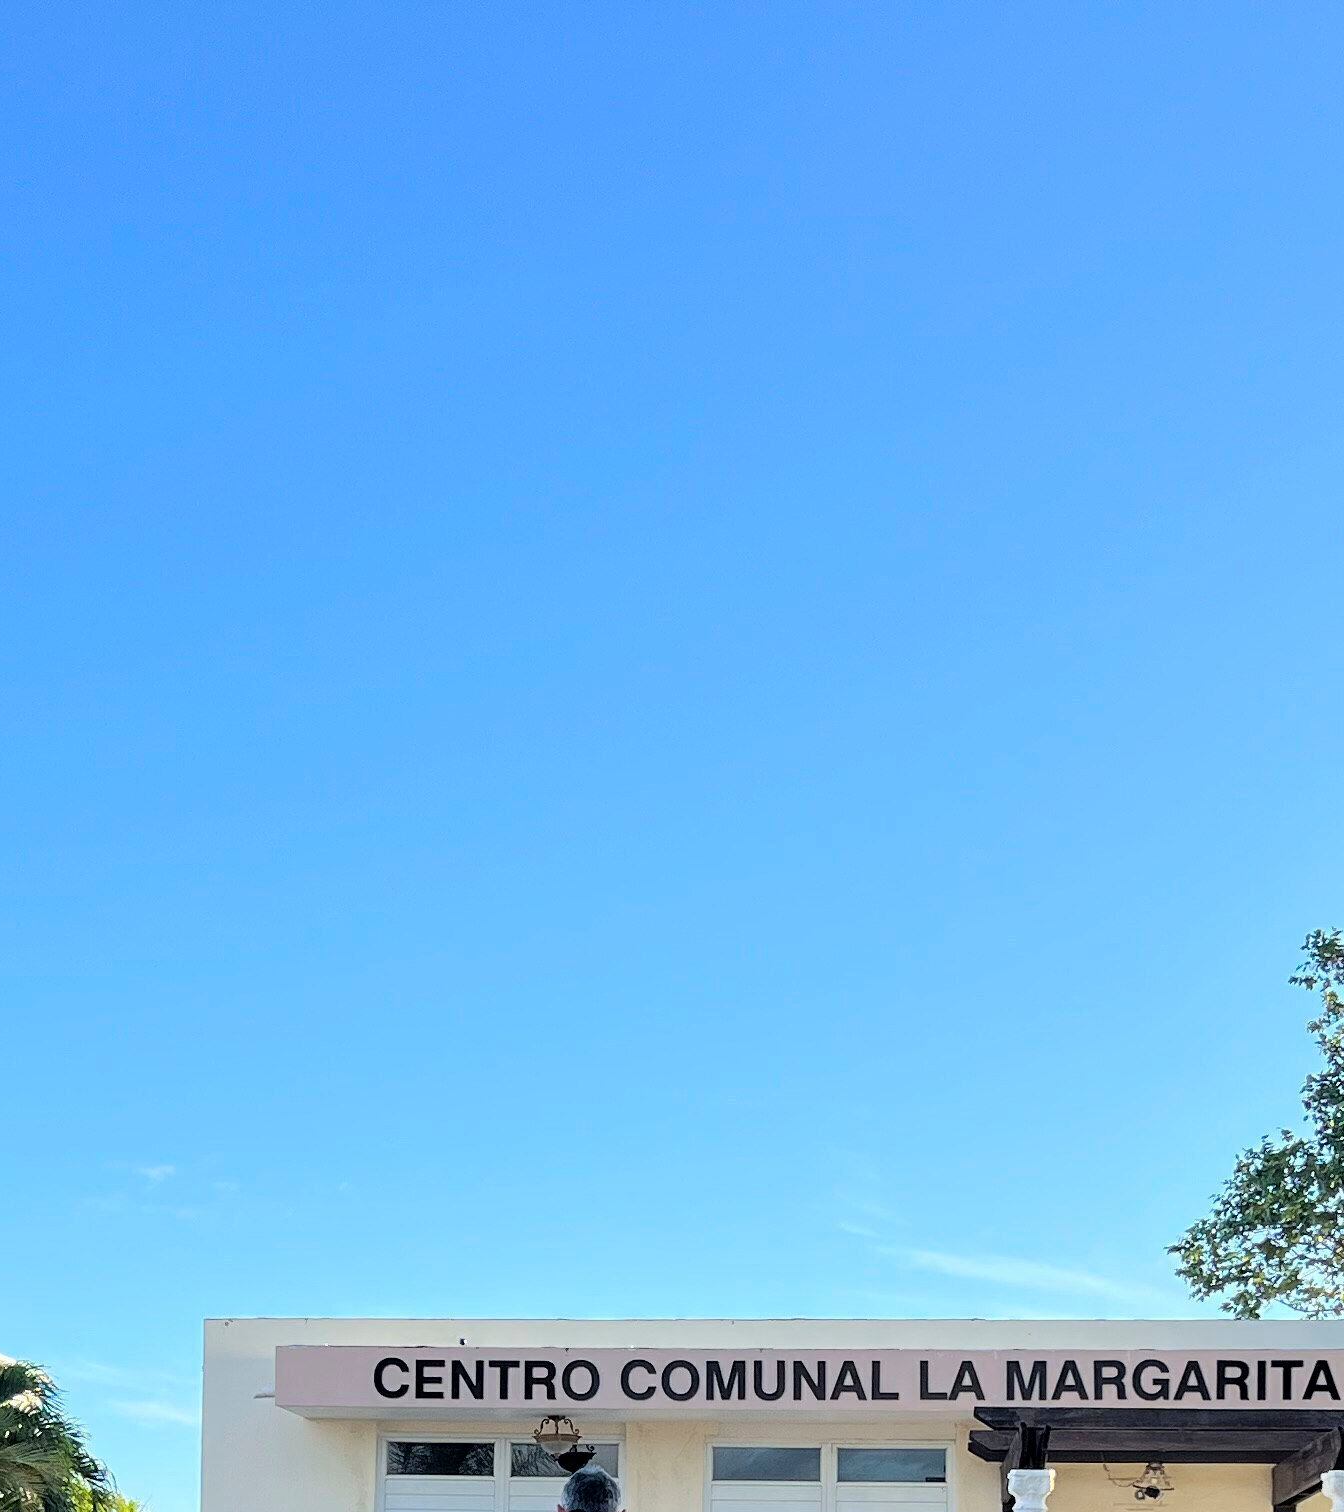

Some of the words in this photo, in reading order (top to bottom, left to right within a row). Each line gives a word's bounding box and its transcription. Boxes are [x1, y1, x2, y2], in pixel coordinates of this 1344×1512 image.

[373, 1357, 600, 1402] CENTRO
[620, 1359, 900, 1402] COMUNAL
[919, 1359, 986, 1401] LA
[1006, 1359, 1341, 1402] MARGARITA
